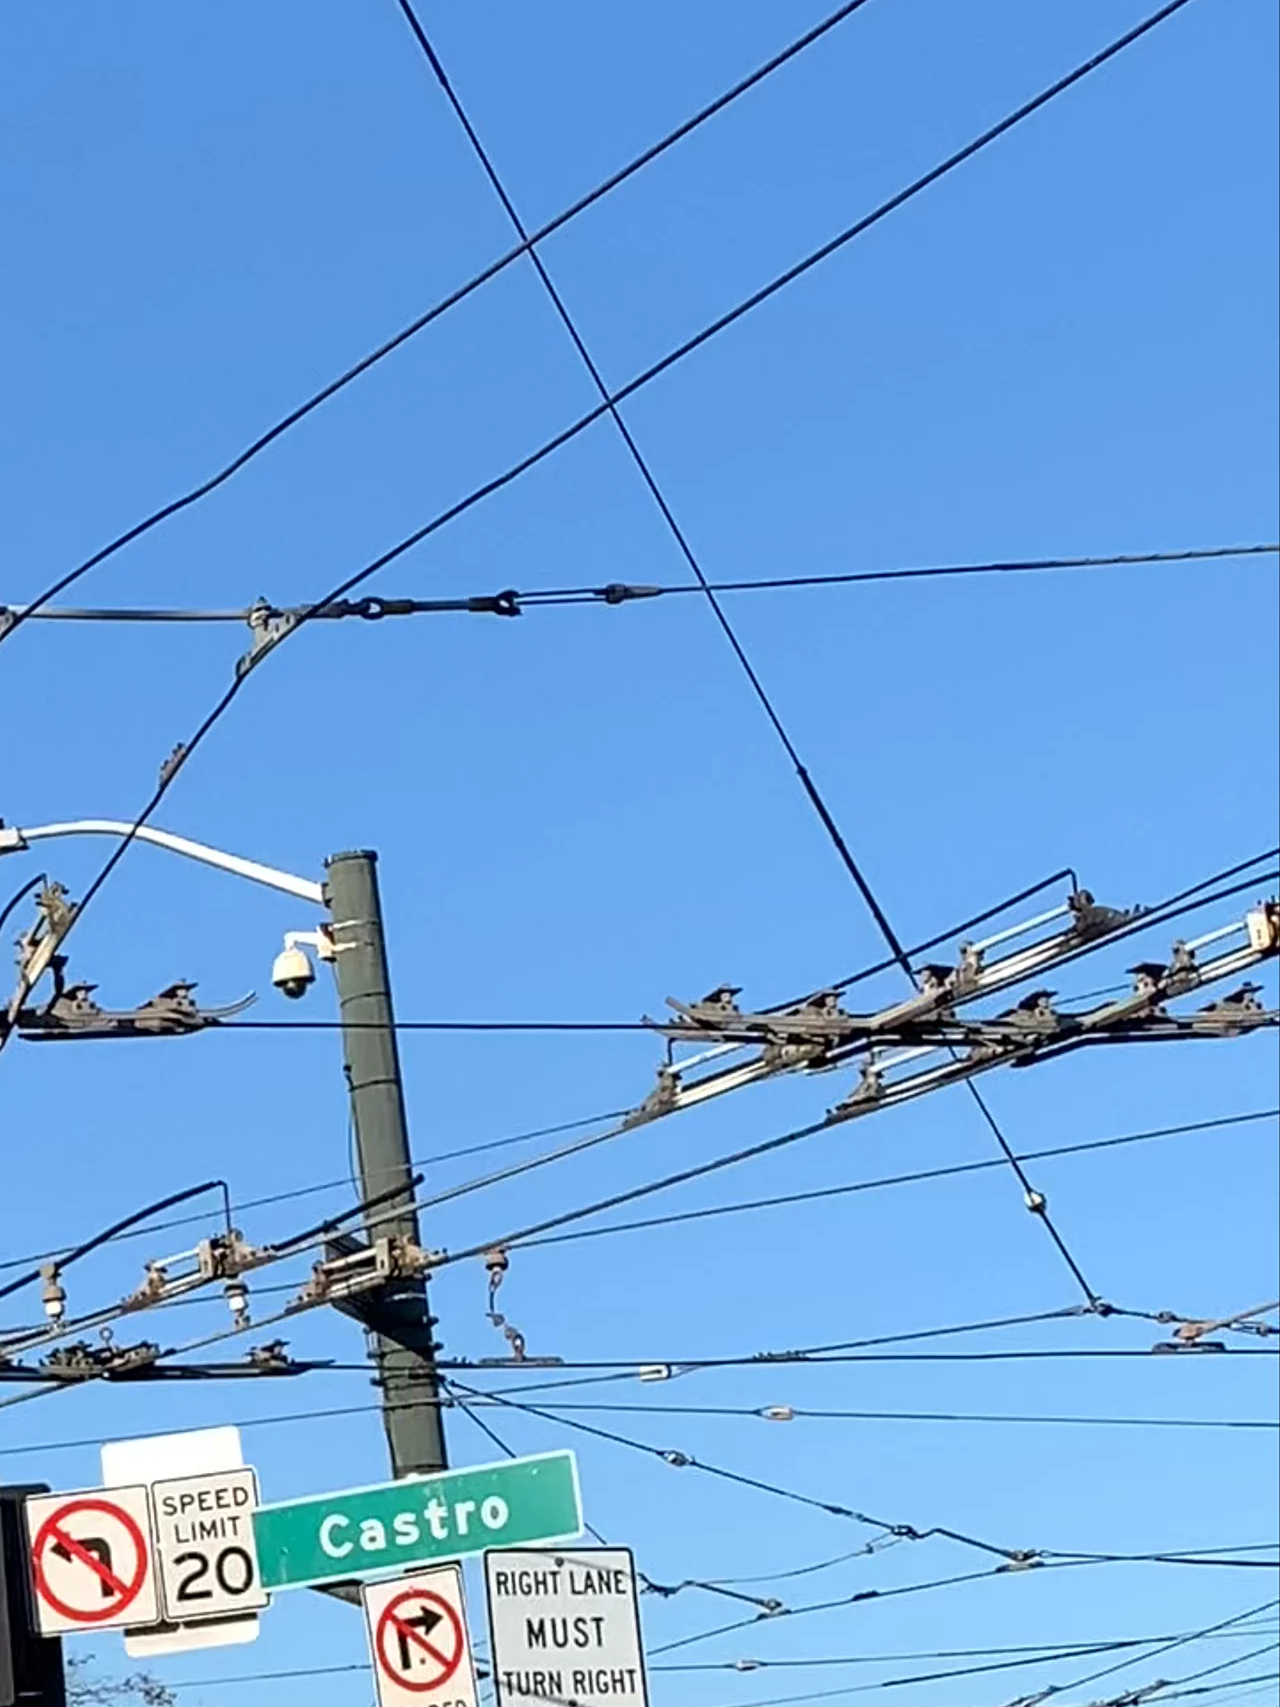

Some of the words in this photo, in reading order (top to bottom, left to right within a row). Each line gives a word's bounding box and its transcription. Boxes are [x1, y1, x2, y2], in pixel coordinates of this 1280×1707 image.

[162, 1487, 249, 1516] SPEED
[174, 1516, 240, 1543] LIMIT
[319, 1496, 509, 1558] Castro
[172, 1546, 254, 1602] 20
[496, 1571, 561, 1596] RIGHT
[569, 1569, 627, 1595] LANE
[526, 1617, 605, 1648] MUST
[502, 1670, 562, 1696] TURN
[572, 1669, 636, 1694] RIGHT
